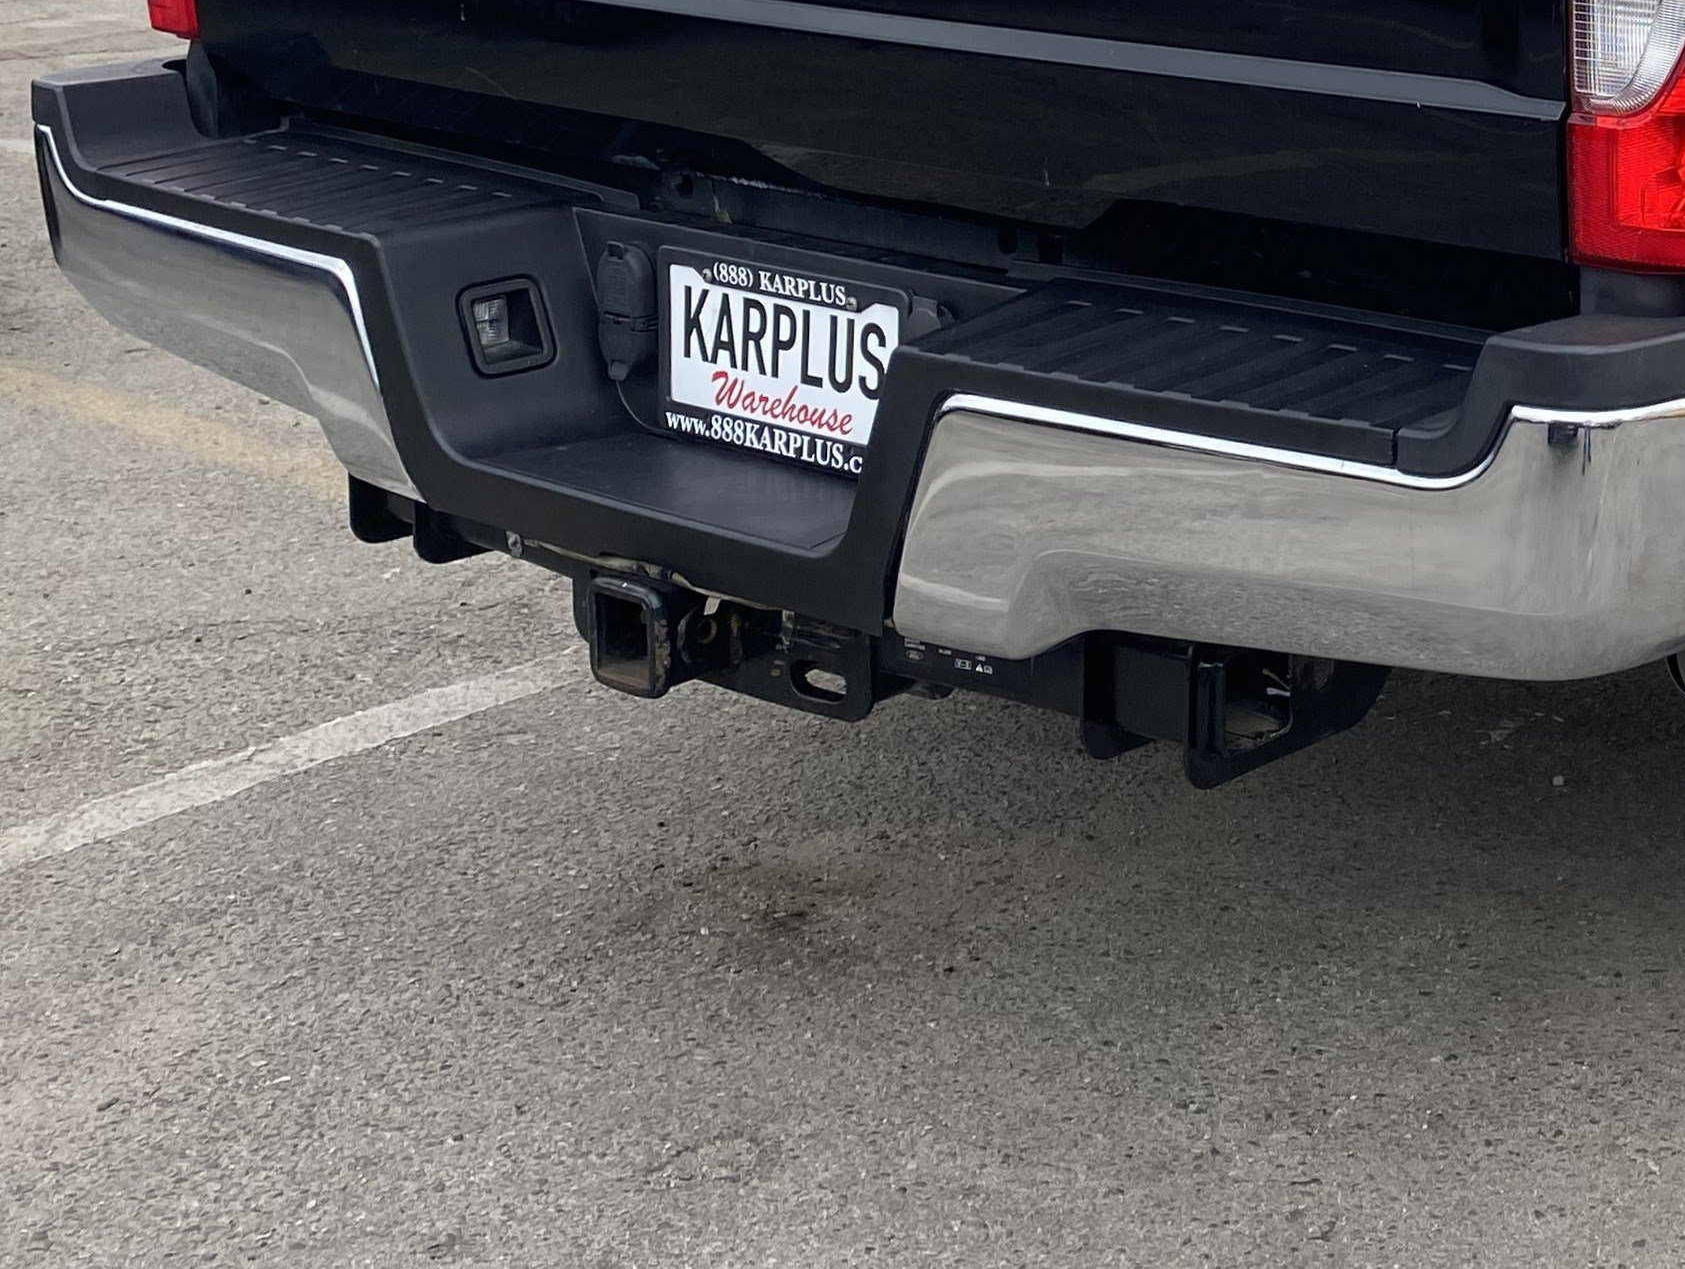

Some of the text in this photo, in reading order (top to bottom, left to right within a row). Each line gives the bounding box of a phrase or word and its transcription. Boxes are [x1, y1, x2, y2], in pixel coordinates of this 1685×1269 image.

[713, 262, 846, 306] (888) KARPLUS
[683, 285, 886, 400] KARPLUS
[711, 370, 853, 435] Warehouse
